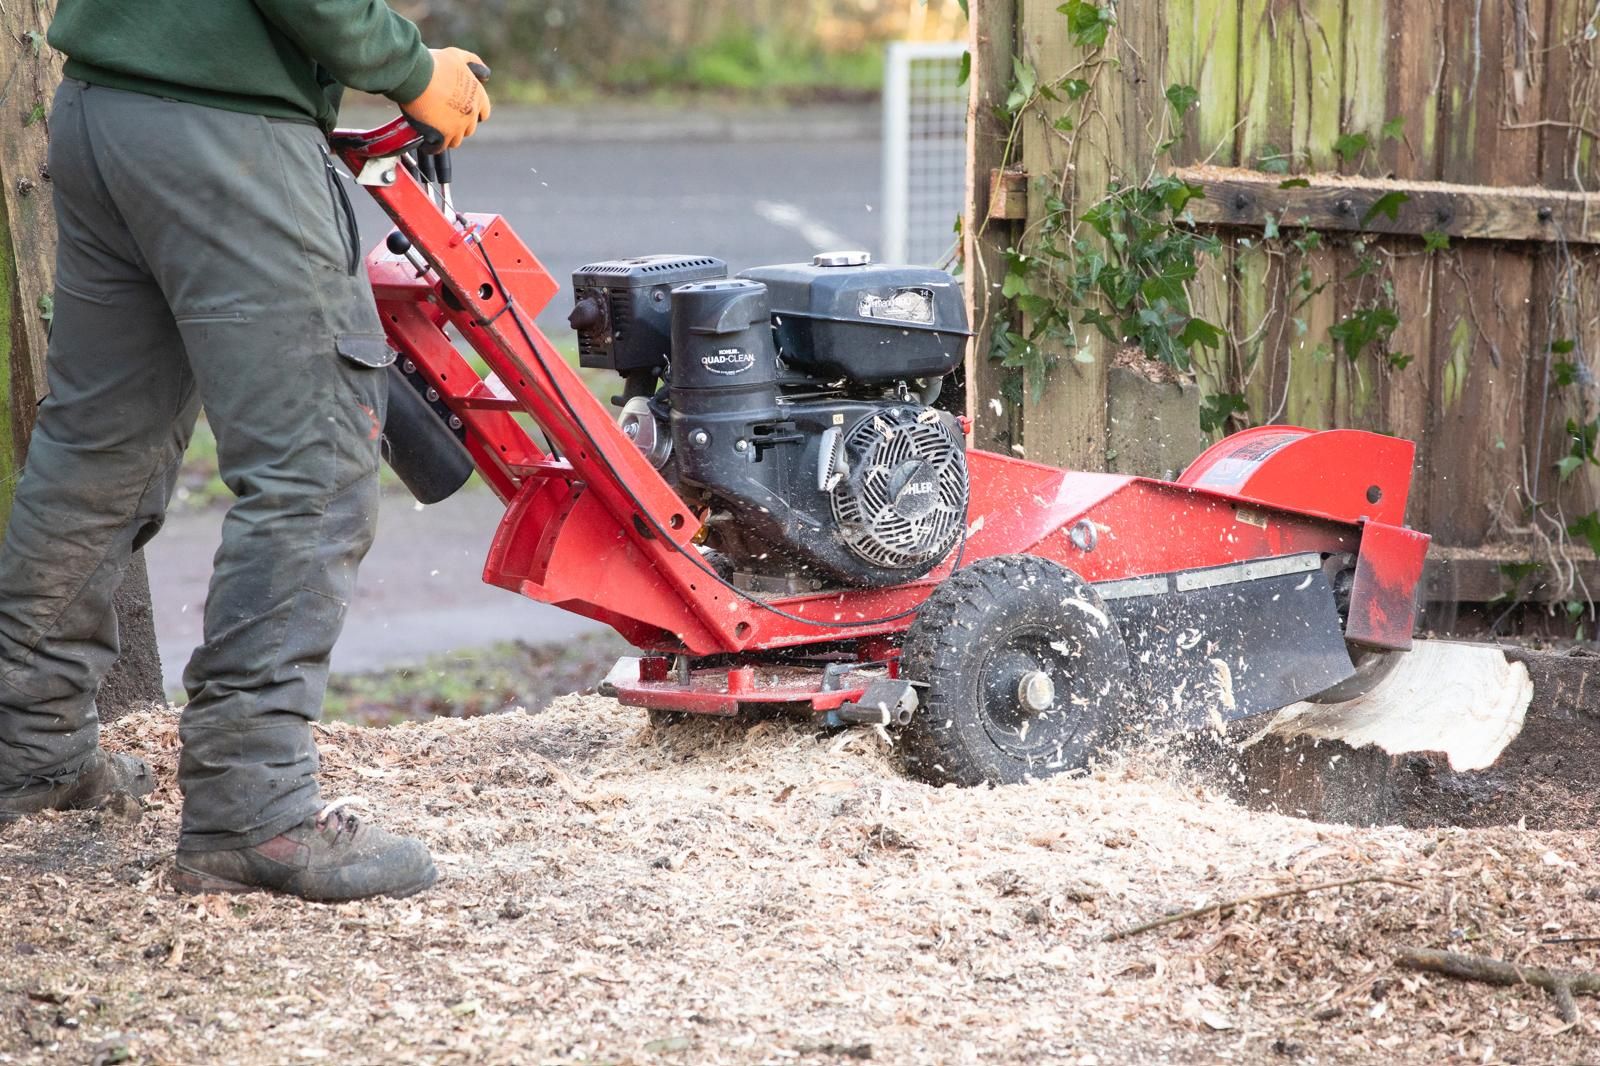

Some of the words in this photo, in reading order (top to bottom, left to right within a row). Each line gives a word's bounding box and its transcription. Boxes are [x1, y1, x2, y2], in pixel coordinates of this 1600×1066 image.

[920, 290, 929, 298] 14
[701, 353, 754, 365] QUAD-CLEAN
[902, 481, 934, 496] OHLER
